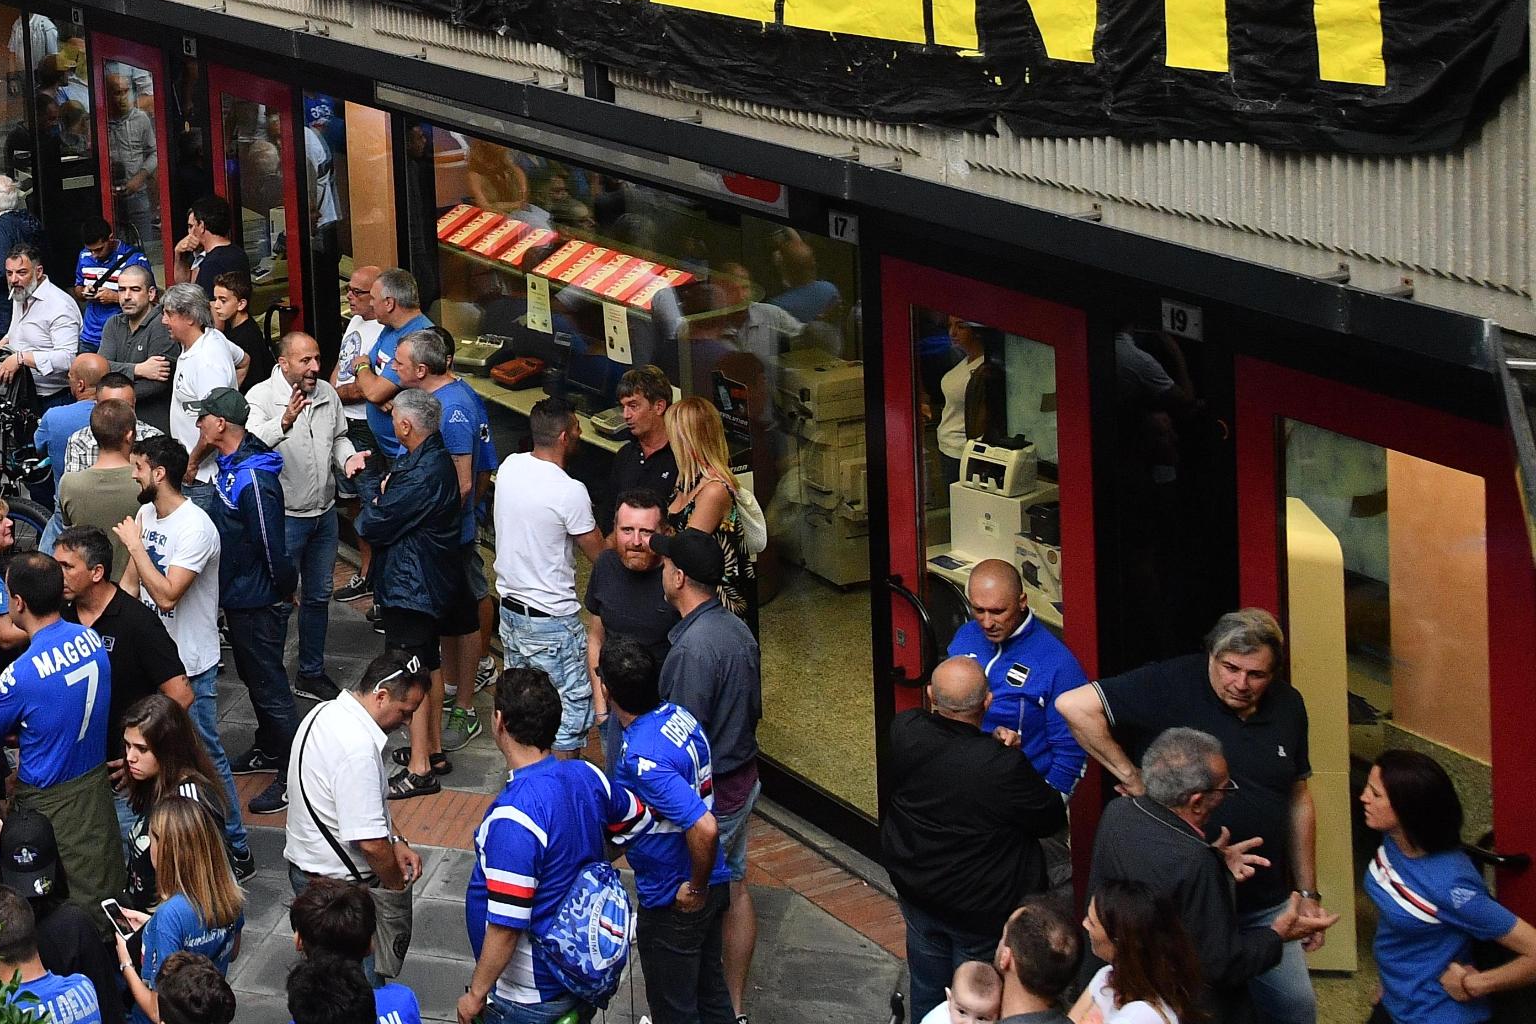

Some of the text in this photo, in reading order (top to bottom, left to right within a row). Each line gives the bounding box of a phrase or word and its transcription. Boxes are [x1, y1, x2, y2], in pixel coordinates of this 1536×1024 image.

[834, 216, 849, 238] 17
[1170, 307, 1188, 333] 19
[32, 628, 102, 679] MAGGIO
[64, 660, 99, 743] 7
